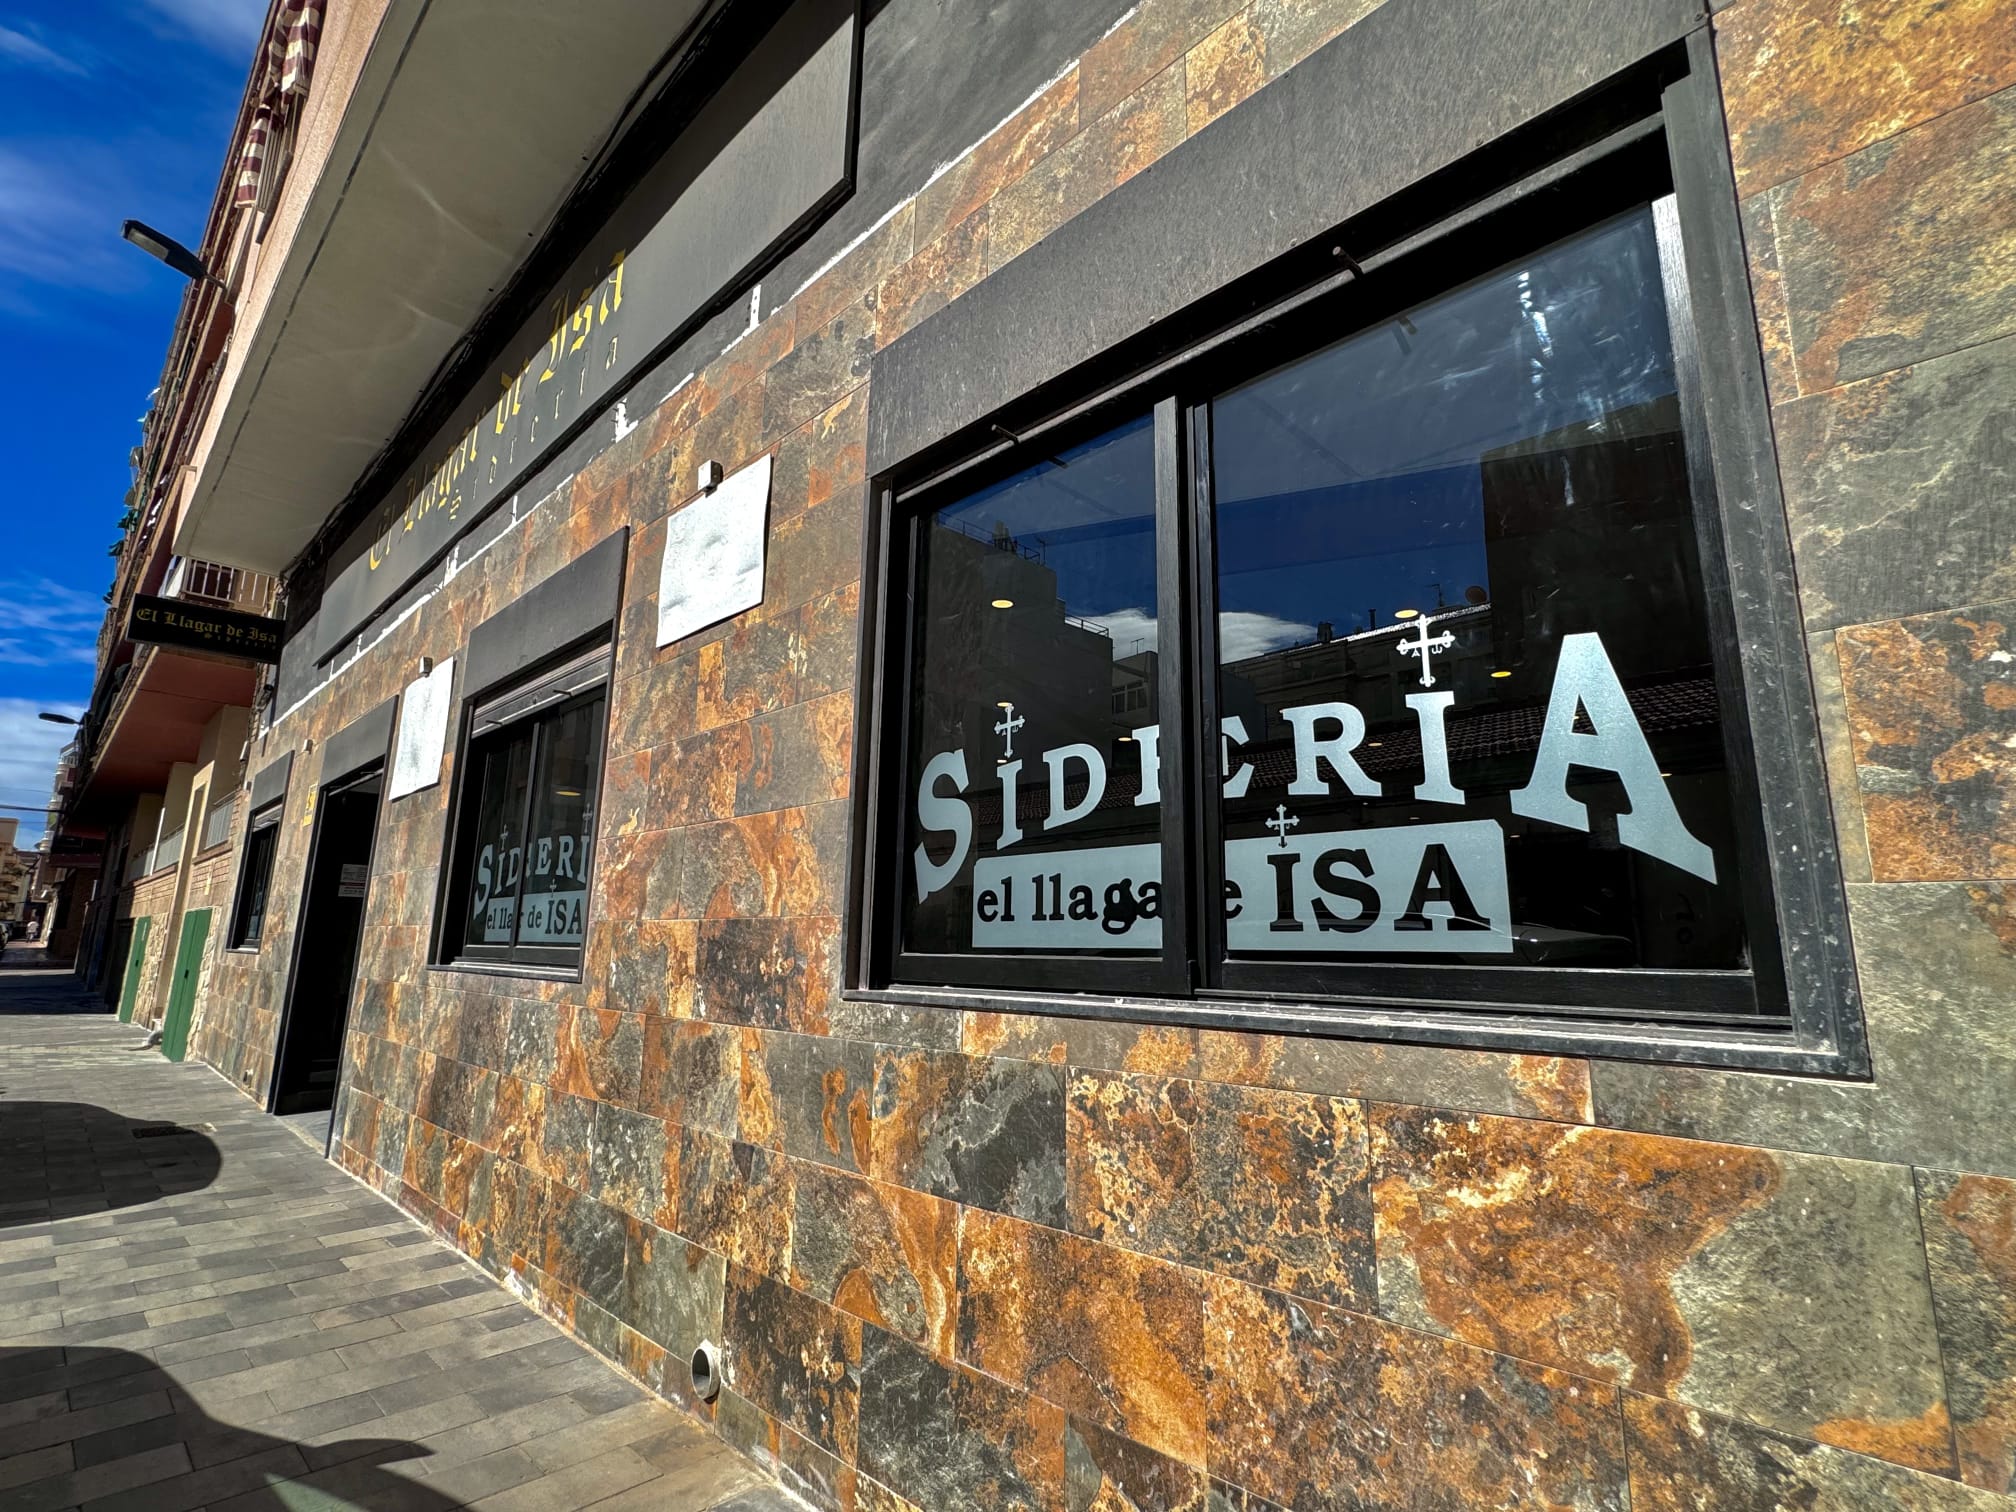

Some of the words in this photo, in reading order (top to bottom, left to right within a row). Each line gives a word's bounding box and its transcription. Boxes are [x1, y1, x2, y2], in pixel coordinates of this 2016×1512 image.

[135, 607, 157, 623] El
[163, 611, 222, 633] Llagar
[226, 623, 245, 638] de
[248, 626, 278, 645] Isa
[977, 872, 1014, 923] el
[1032, 872, 1163, 935] llaga
[1267, 843, 1491, 934] ISA
[486, 908, 497, 930] el
[527, 905, 542, 929] de
[545, 899, 582, 935] ISA
